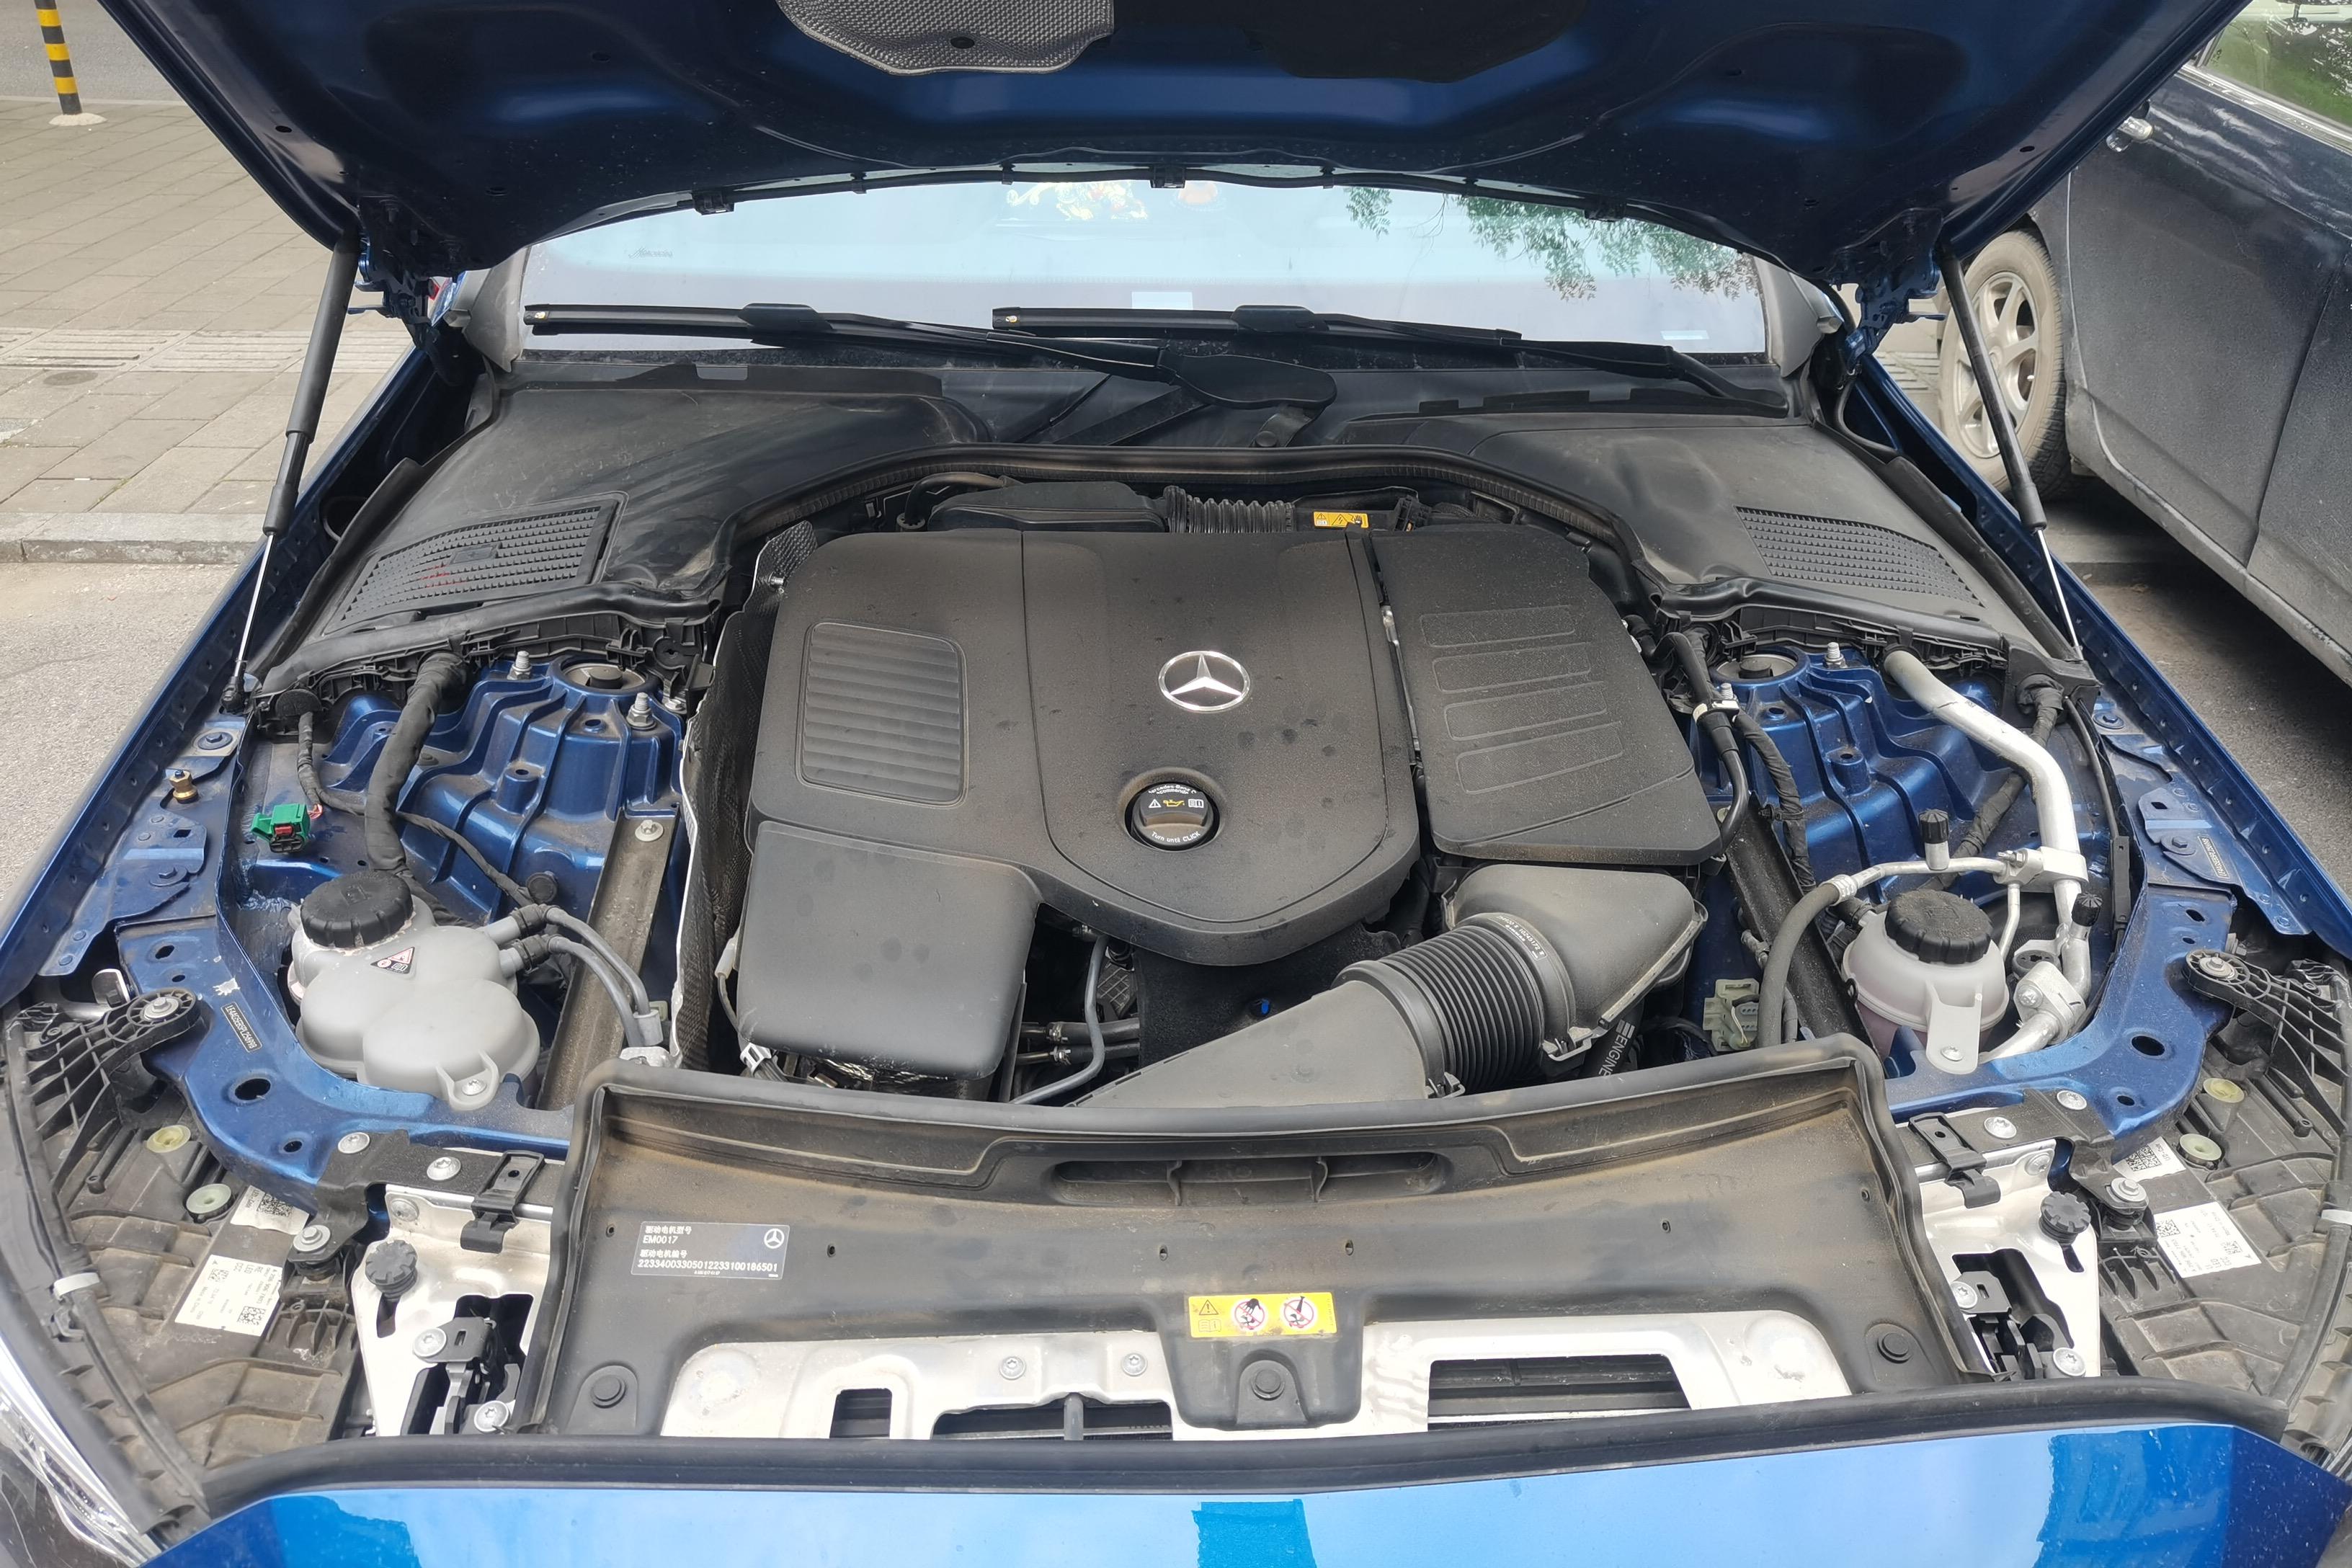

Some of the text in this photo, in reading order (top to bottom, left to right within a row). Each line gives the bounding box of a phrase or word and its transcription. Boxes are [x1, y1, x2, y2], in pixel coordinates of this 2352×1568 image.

[1148, 784, 1191, 794] ercedes-Benz
[1152, 831, 1164, 841] Turn
[1182, 831, 1200, 842] CLICK
[645, 1226, 692, 1235] 驱动电机型号
[643, 1235, 678, 1244] EM0017
[639, 1249, 687, 1259] 驱动电机编号
[638, 1259, 778, 1273] 22334003305012233100186501
